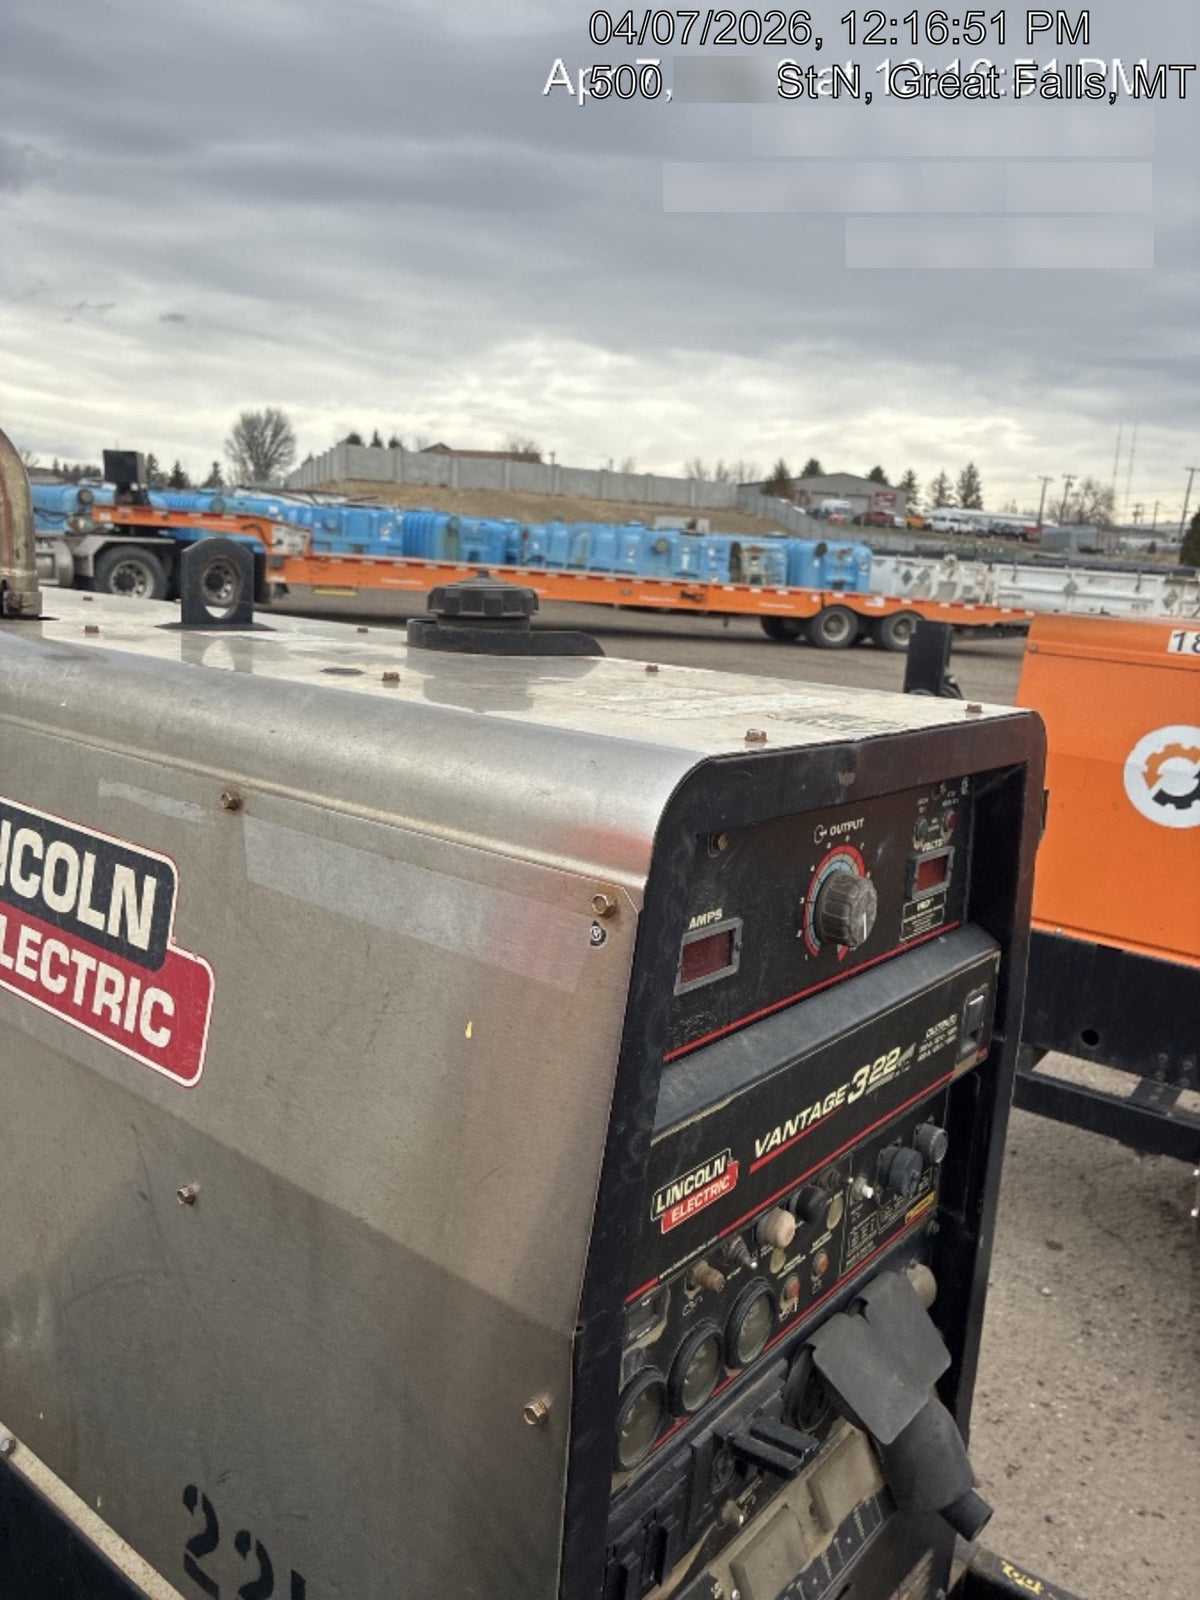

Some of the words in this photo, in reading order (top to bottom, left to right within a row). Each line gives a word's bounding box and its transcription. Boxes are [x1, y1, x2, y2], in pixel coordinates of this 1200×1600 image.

[829, 817, 865, 837] OUTPUT
[688, 907, 724, 930] AMPS
[754, 1086, 849, 1158] VANTAGE
[847, 1046, 902, 1105] 322
[655, 1153, 728, 1214] LINCOLN
[670, 1174, 731, 1223] ELECTRIC
